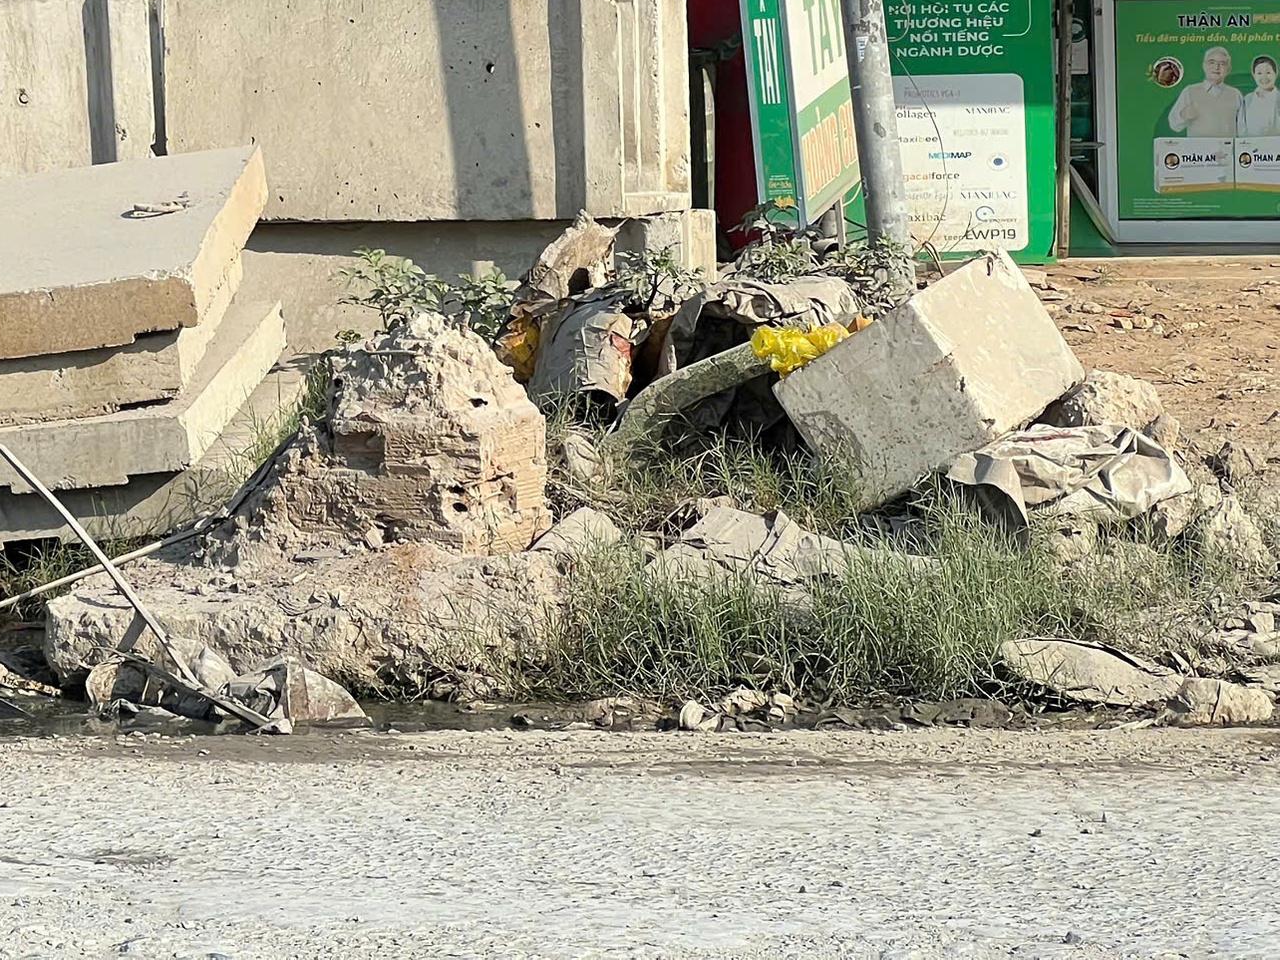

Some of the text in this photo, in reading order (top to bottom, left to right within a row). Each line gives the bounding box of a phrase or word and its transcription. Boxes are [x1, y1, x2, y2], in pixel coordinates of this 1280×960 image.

[952, 3, 973, 16] TỤ
[977, 0, 1010, 13] CÁC
[894, 15, 1004, 29] THƯƠNG HIỆU
[1177, 11, 1221, 31] THẬN
[1226, 14, 1250, 27] AN
[942, 29, 990, 42] TIẾNG
[896, 44, 1004, 58] NGÀNH DƯỢC
[928, 151, 972, 159] MEDIMAP
